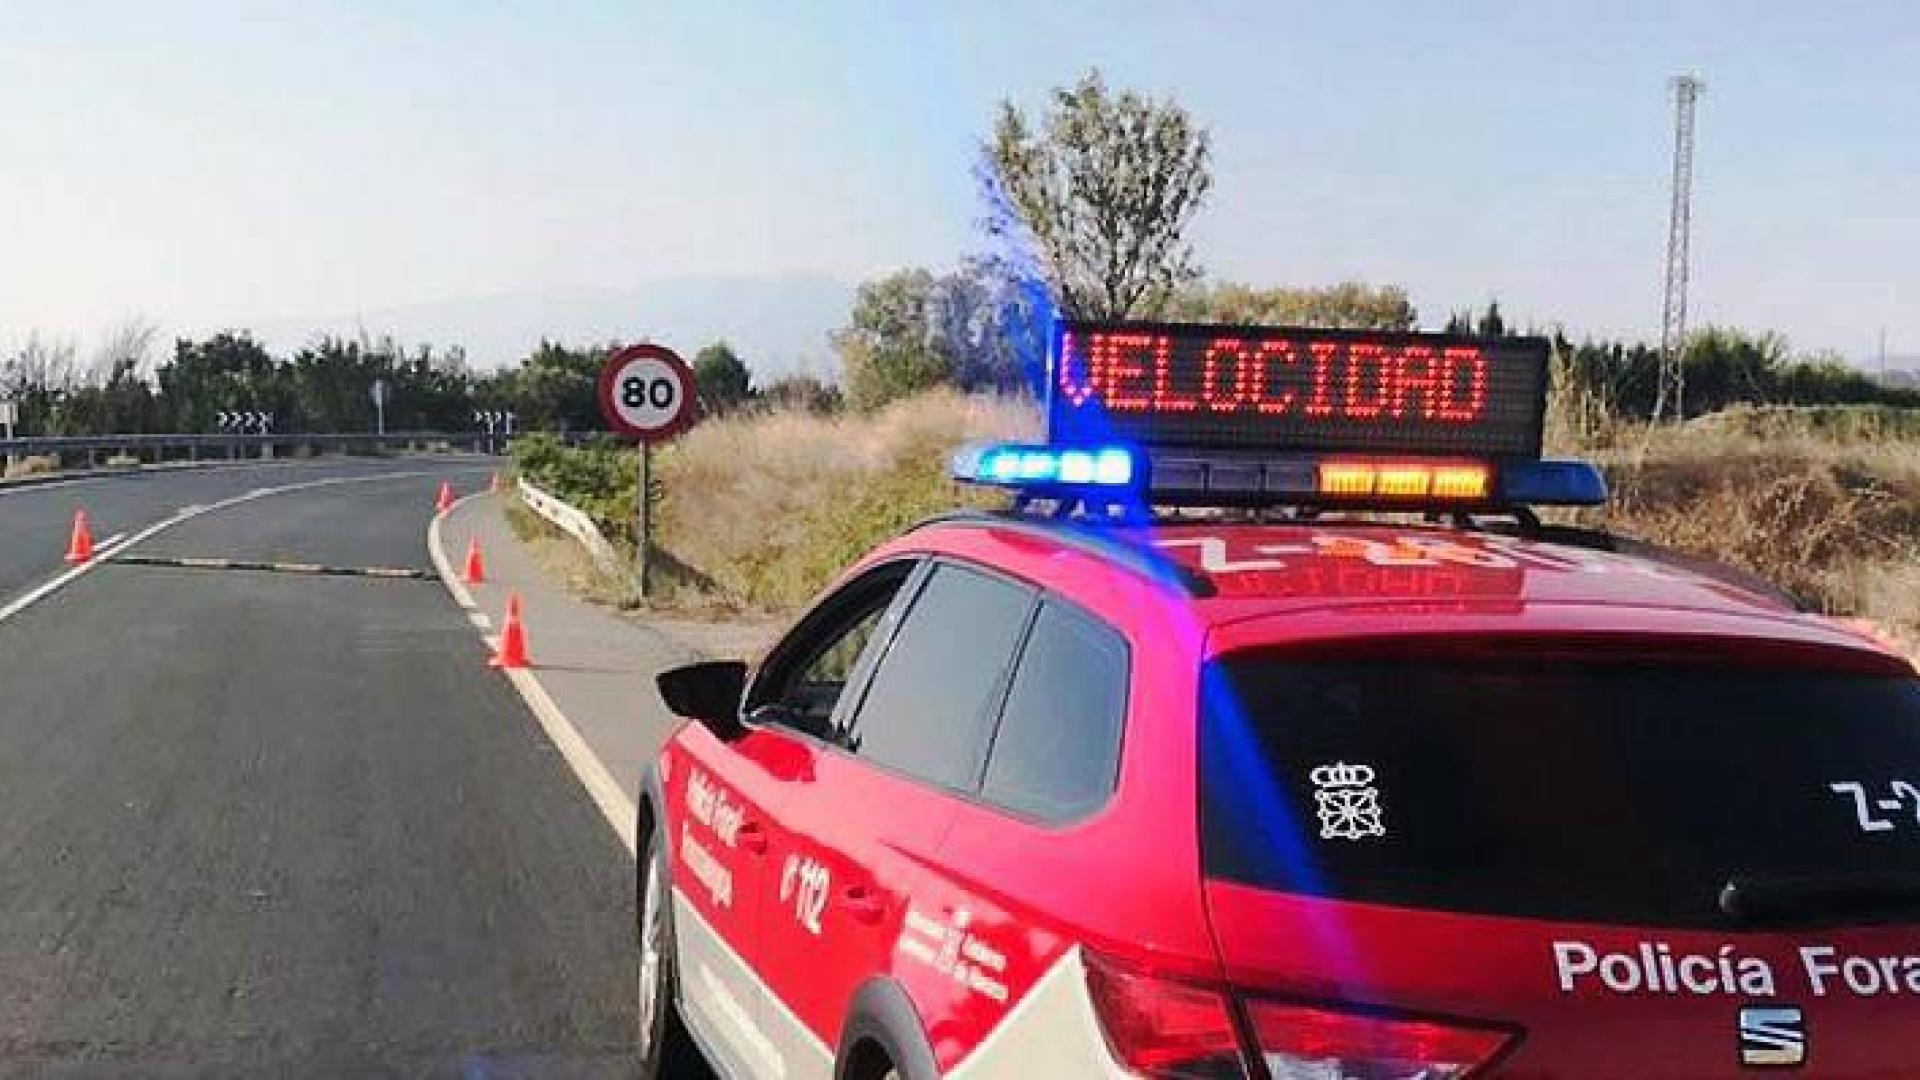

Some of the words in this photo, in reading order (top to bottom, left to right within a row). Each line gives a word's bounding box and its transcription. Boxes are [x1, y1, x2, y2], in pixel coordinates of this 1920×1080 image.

[623, 377, 674, 409] 80
[1060, 332, 1486, 420] VELOCIDAD
[1553, 941, 1776, 996] Policía
